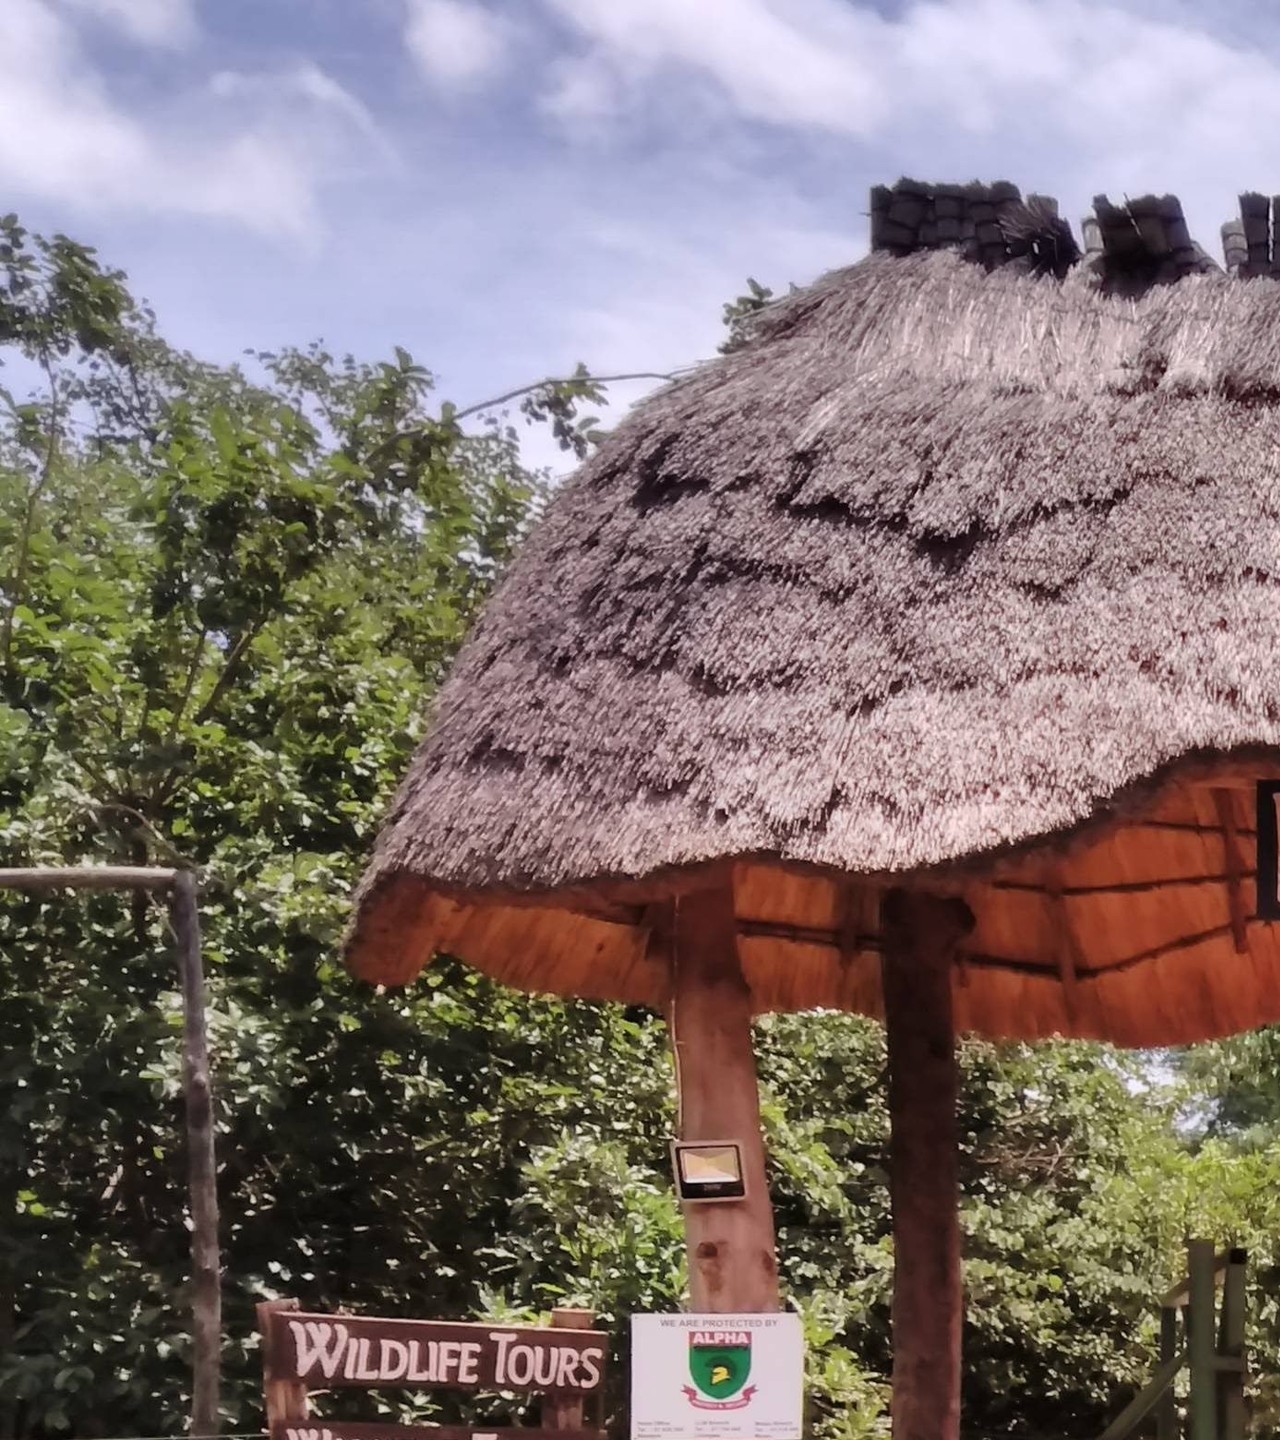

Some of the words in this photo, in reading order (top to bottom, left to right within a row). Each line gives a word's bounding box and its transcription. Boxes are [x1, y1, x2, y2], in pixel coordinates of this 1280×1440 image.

[660, 1319, 677, 1328] WE
[679, 1319, 700, 1328] ARE
[702, 1319, 762, 1328] PROTECTED
[765, 1319, 778, 1328] BY
[693, 1332, 749, 1344] ALPHA
[288, 1320, 482, 1384] WILDLIFE
[489, 1331, 603, 1389] TOURS
